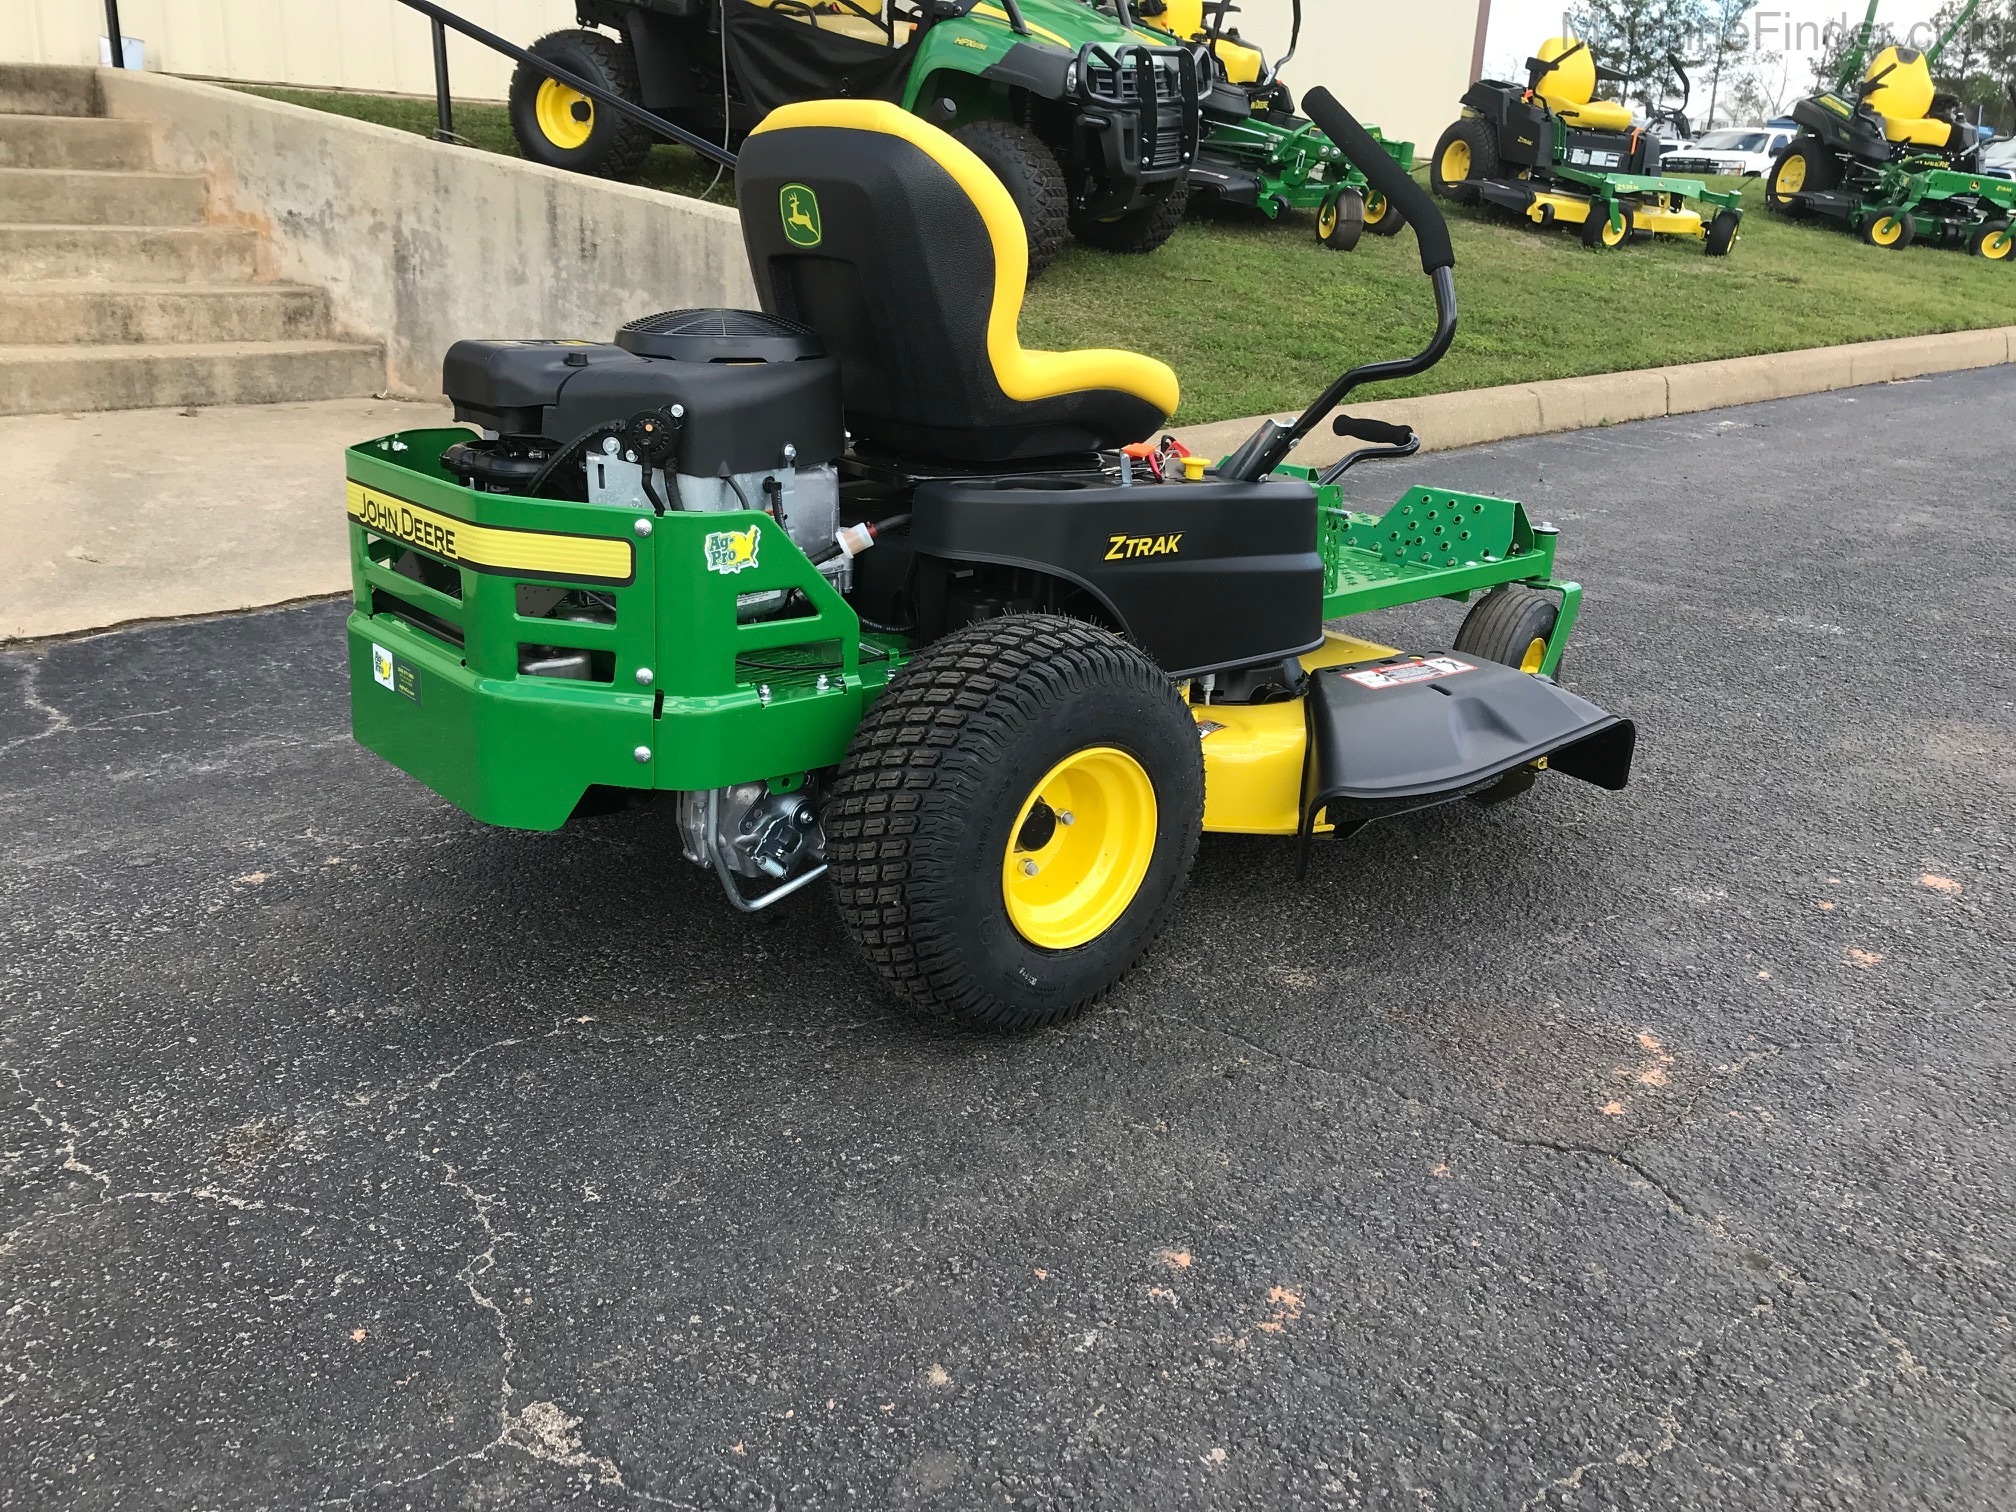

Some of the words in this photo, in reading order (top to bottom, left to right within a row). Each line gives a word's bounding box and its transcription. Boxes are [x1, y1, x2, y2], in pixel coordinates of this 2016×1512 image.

[359, 492, 399, 533] JOHN
[400, 506, 458, 555] DEERE
[1104, 534, 1182, 561] ZTRAK
